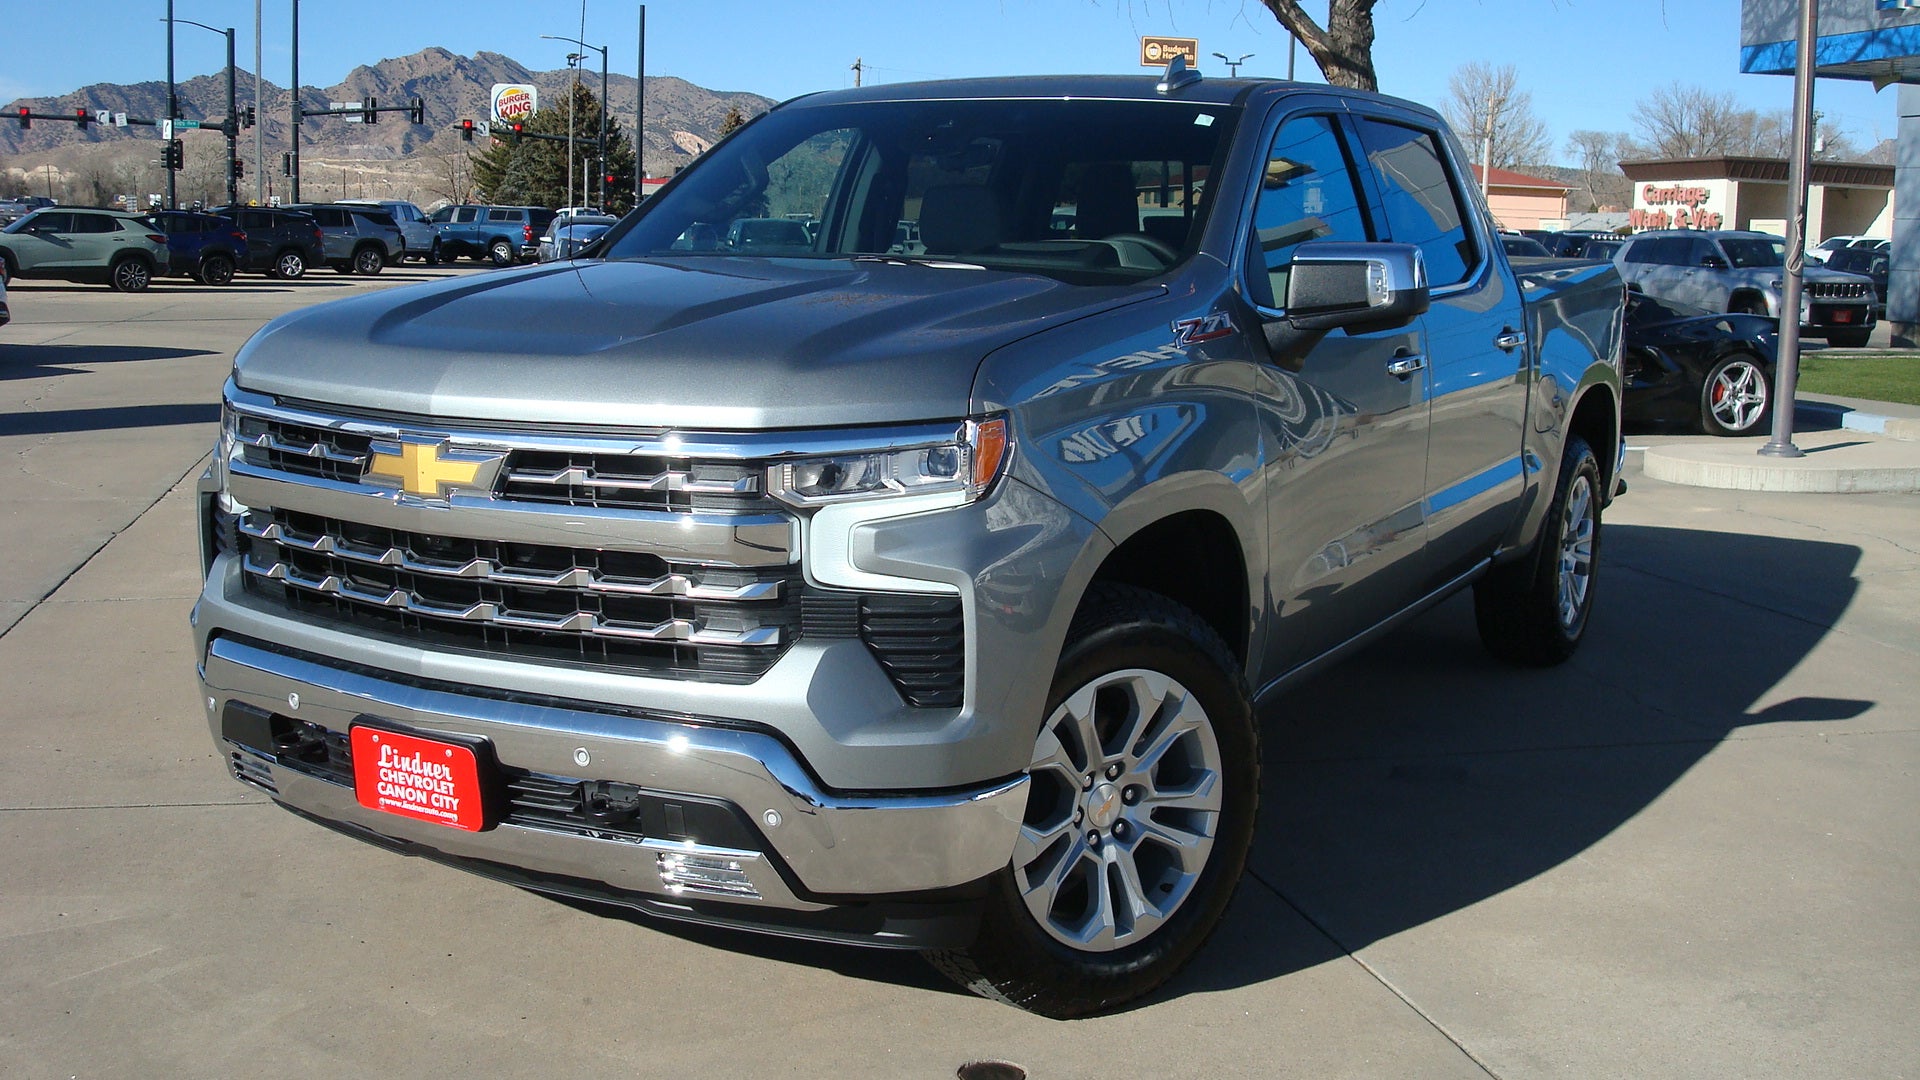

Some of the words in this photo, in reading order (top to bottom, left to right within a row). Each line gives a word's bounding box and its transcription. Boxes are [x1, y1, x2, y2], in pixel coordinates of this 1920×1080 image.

[1162, 44, 1190, 54] Budget
[498, 93, 530, 107] BURGER
[500, 101, 531, 119] KING
[1643, 184, 1708, 207] Carriage
[1629, 208, 1670, 229] Wash
[1674, 208, 1688, 228] &
[1690, 206, 1722, 229] Vac
[1170, 310, 1233, 348] Z71
[377, 744, 453, 781] Lindner
[379, 768, 455, 796] CHEVROLET
[377, 781, 427, 804] CANON
[430, 793, 460, 811] CITY
